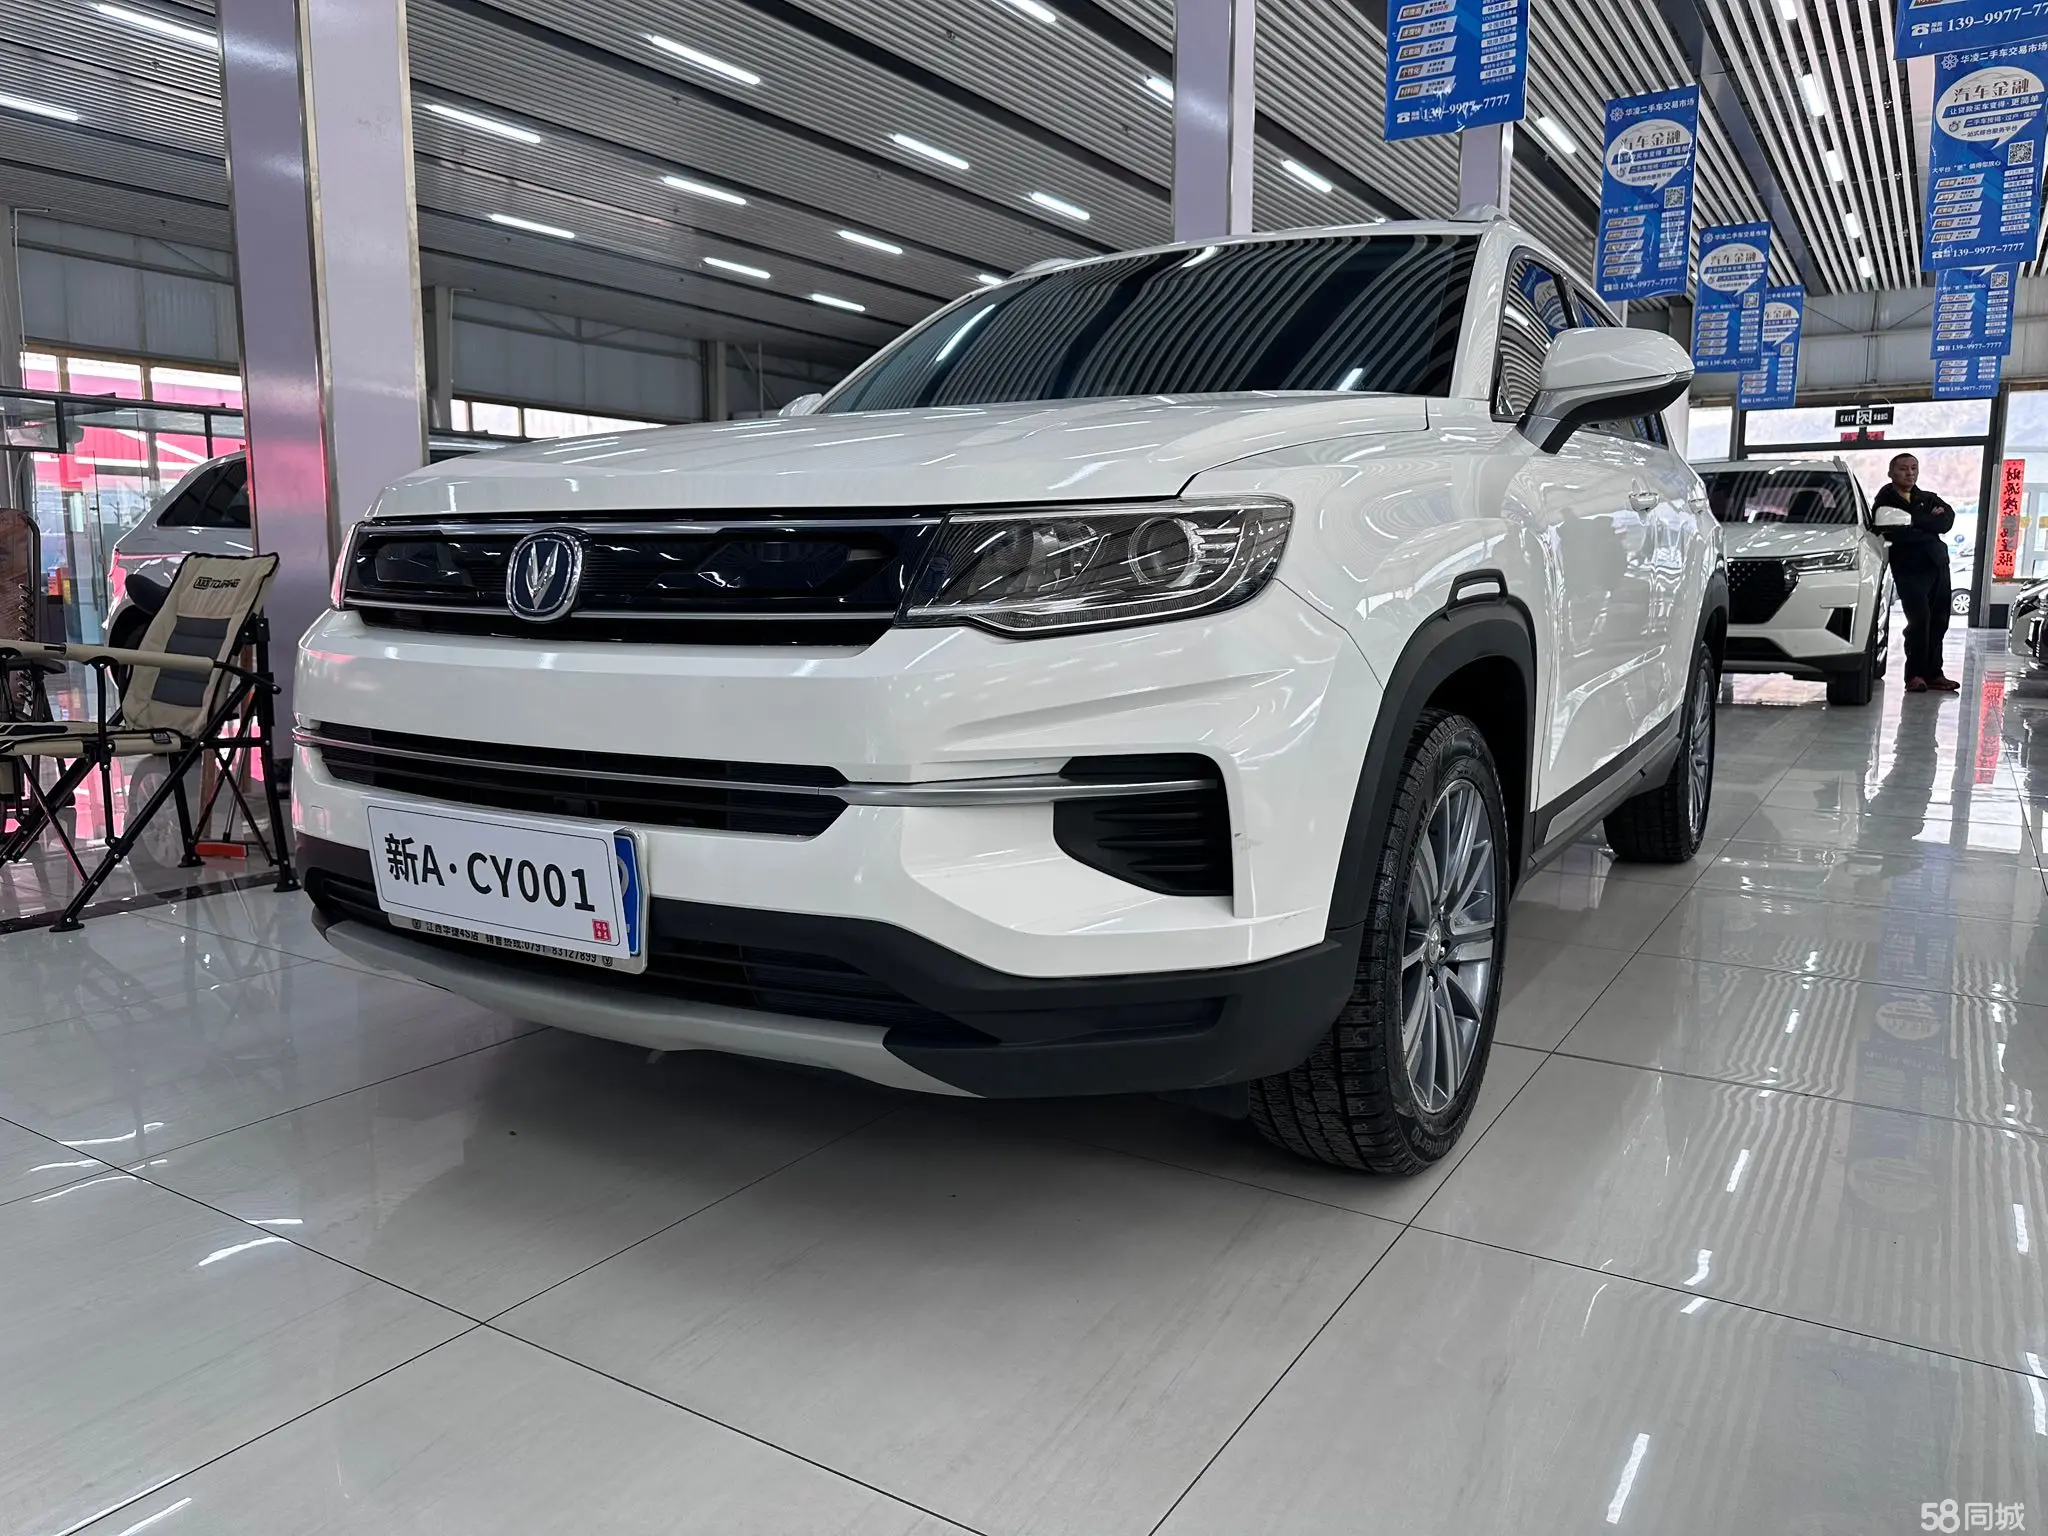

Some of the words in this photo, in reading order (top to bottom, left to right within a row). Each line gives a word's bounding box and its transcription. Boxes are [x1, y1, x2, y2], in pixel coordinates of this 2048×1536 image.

[1960, 41, 2048, 64] 华凌二手车交易市场
[1953, 78, 2030, 103] 汽车金融
[1424, 94, 1510, 120] 139-9977-7777
[1625, 97, 1695, 117] 华凌二手车交易市场
[1620, 129, 1681, 150] 汽车金融
[1961, 125, 2018, 138] 一站式综合服务平台
[1953, 242, 2025, 258] 139-9977-7777
[1840, 414, 1855, 423] EXIT
[383, 832, 596, 913] 新A·CY001
